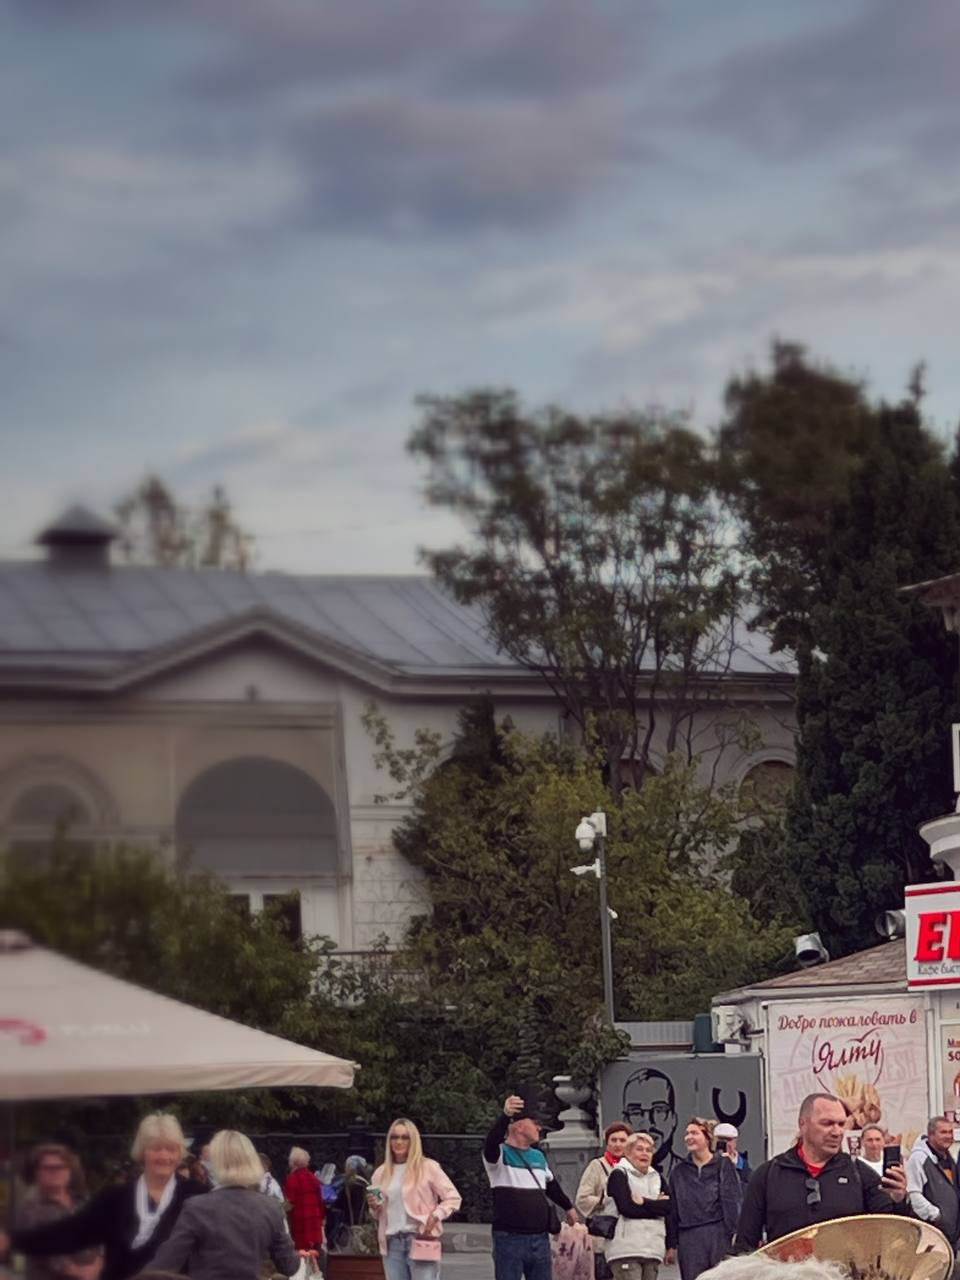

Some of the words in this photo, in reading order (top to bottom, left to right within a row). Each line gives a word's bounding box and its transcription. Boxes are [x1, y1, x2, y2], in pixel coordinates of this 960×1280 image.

[917, 964, 940, 976] Кафе
[778, 1014, 817, 1034] Добро
[819, 1011, 906, 1029] пожаловать
[909, 1008, 918, 1024] в
[813, 1039, 882, 1075] Ялту
